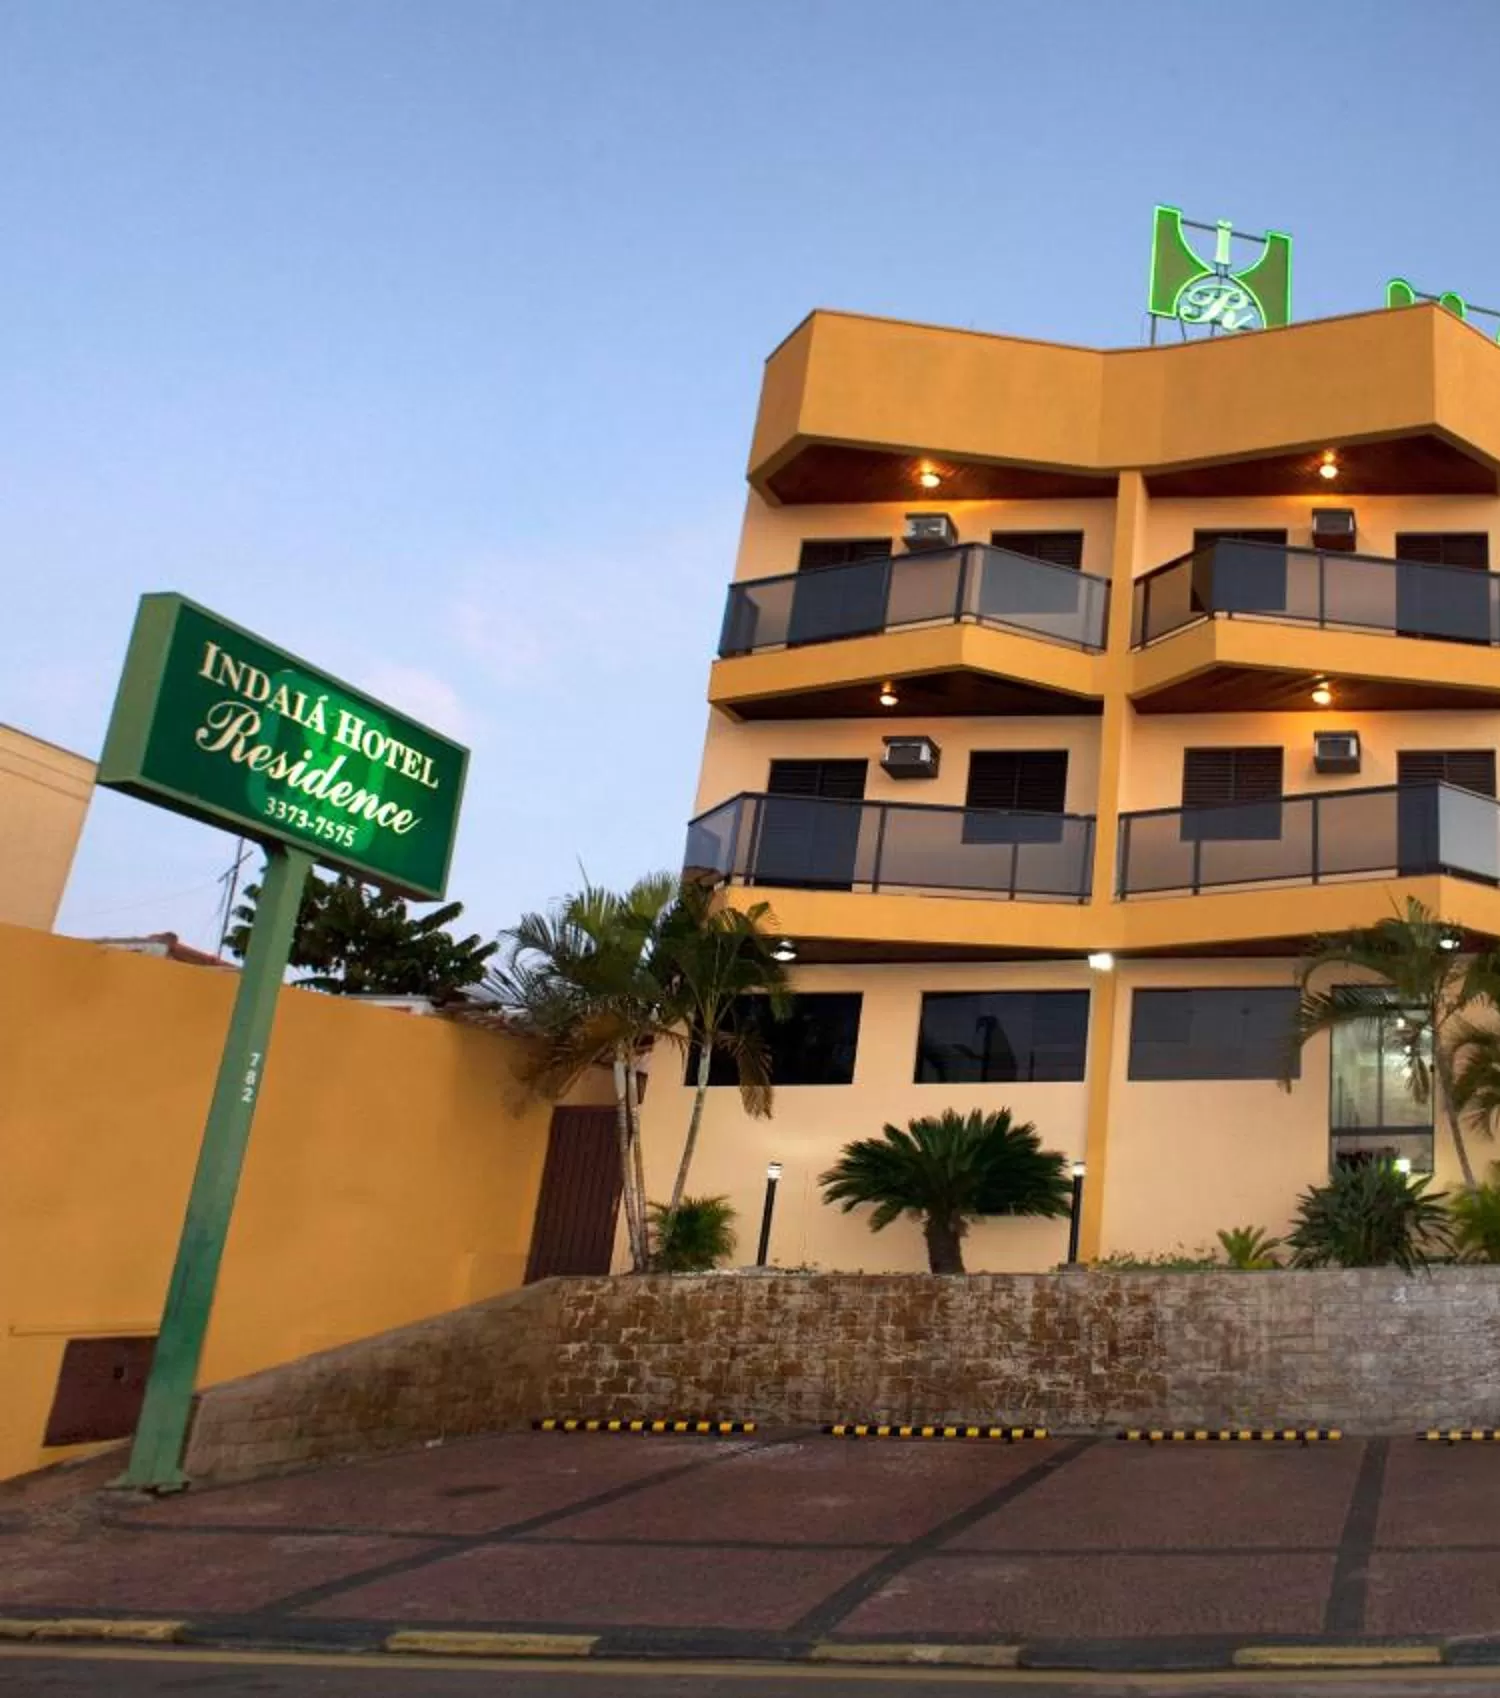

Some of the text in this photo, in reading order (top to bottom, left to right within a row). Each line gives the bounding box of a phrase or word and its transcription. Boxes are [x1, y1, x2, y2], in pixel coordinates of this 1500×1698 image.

[194, 699, 423, 835] Residence
[198, 640, 439, 789] INDAIÁ HOTEL
[263, 796, 359, 848] 3373-7575
